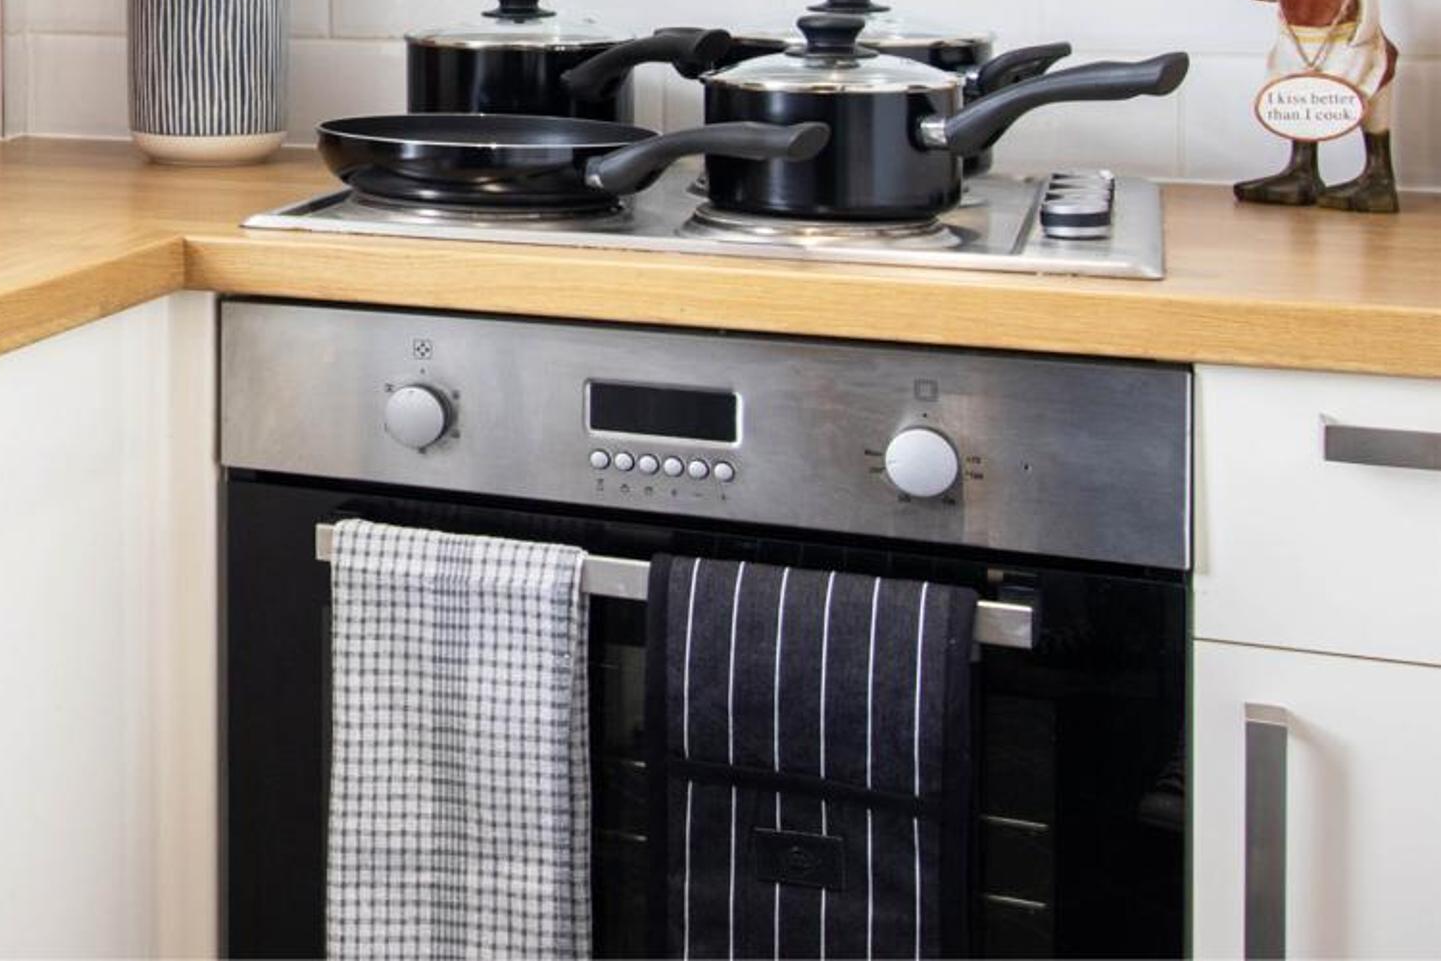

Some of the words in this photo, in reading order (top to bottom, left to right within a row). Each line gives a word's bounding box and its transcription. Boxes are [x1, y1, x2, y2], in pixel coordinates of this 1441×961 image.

[1267, 92, 1273, 105] I
[1277, 92, 1307, 105] kiss
[1310, 92, 1355, 105] better
[1267, 107, 1300, 121] than
[1305, 107, 1311, 121] I
